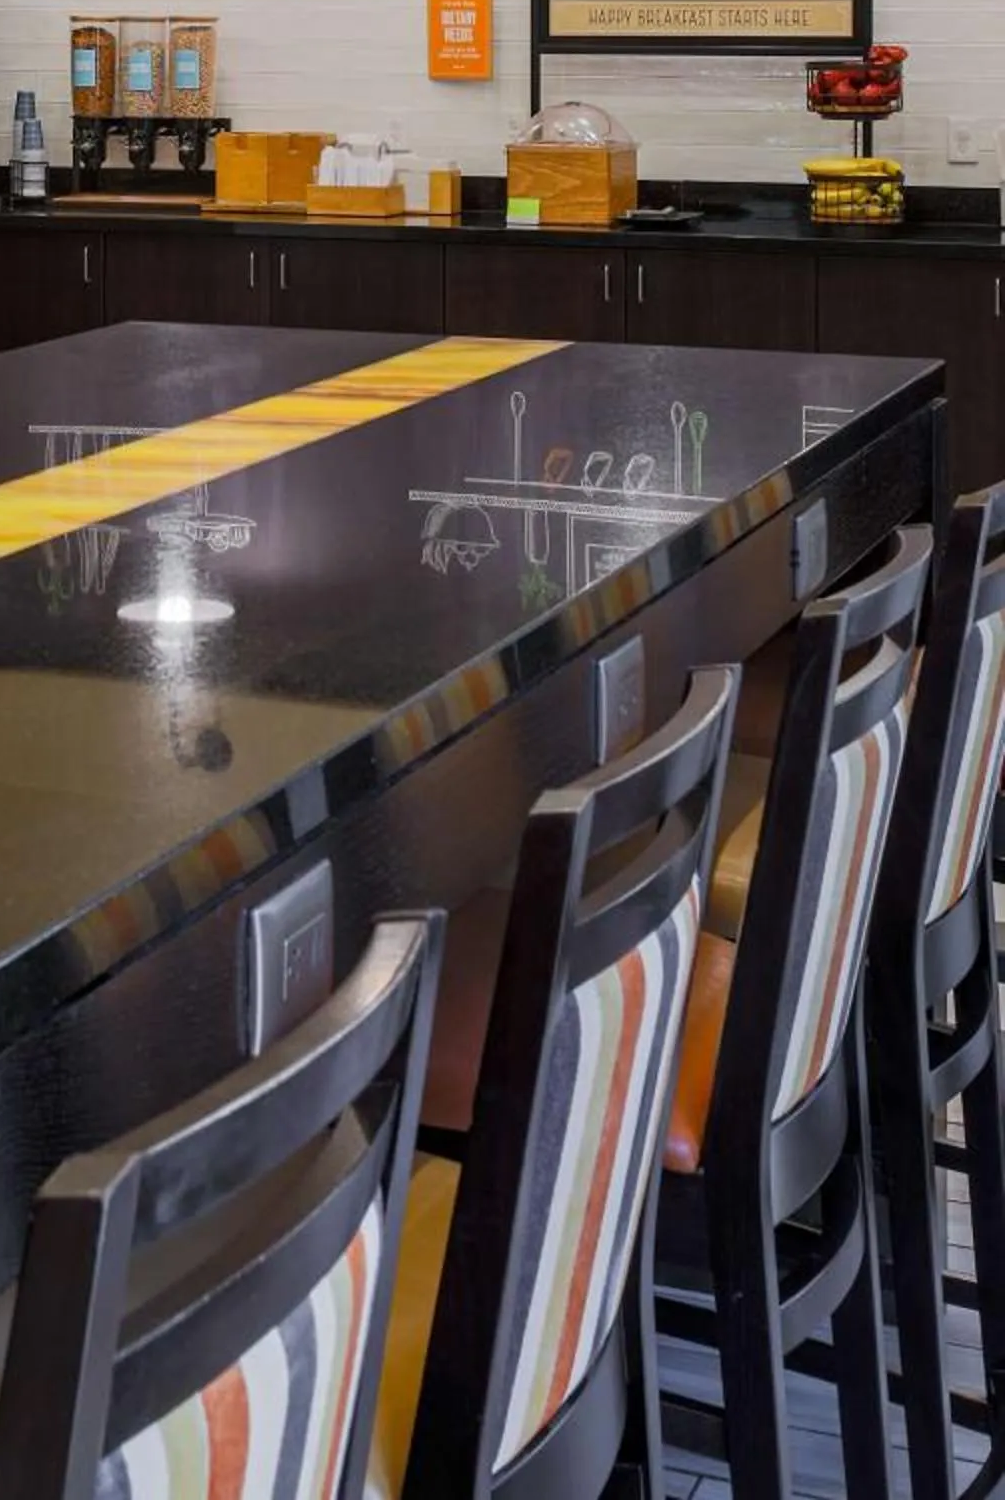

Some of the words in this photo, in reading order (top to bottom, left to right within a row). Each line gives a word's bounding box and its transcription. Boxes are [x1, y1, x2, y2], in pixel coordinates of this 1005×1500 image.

[440, 10, 476, 25] DIETARY
[588, 8, 633, 28] HAPPY
[638, 9, 713, 29] BREAKFAST
[718, 9, 768, 28] STARTS
[774, 10, 812, 28] HERE
[443, 27, 474, 43] NEEDS
